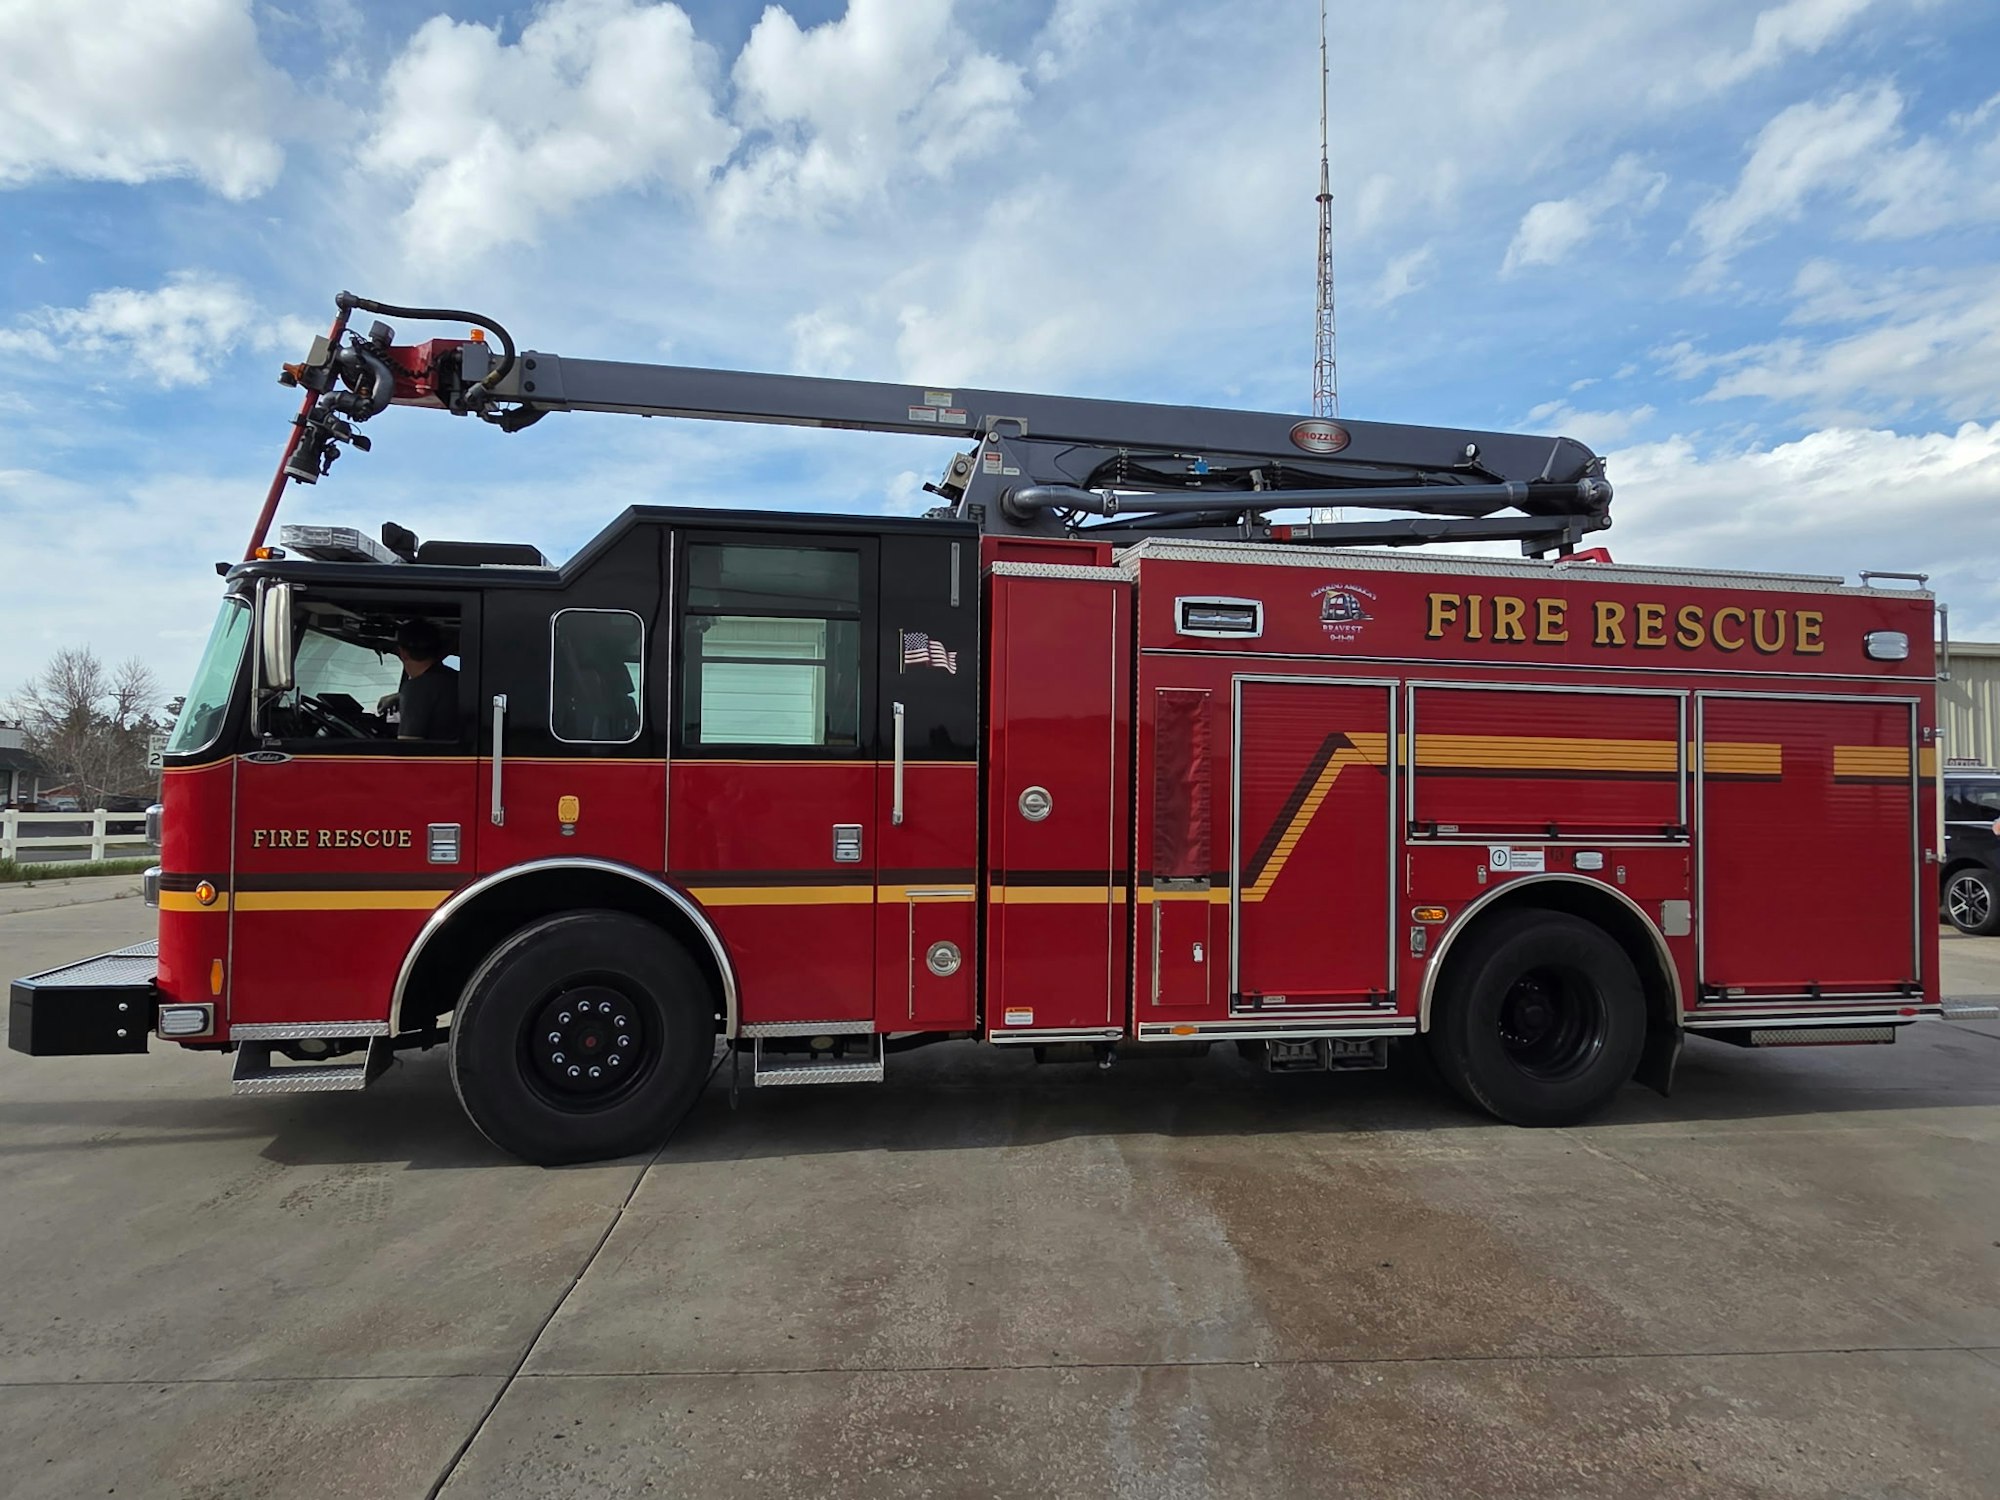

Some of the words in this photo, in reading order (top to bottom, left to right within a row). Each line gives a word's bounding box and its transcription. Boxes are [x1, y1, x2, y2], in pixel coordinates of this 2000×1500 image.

[1426, 592, 1569, 643] FIRE
[1593, 600, 1825, 653] RESCUE
[150, 752, 161, 766] 2
[253, 829, 310, 848] FIRE
[317, 829, 412, 848] RESCUE
